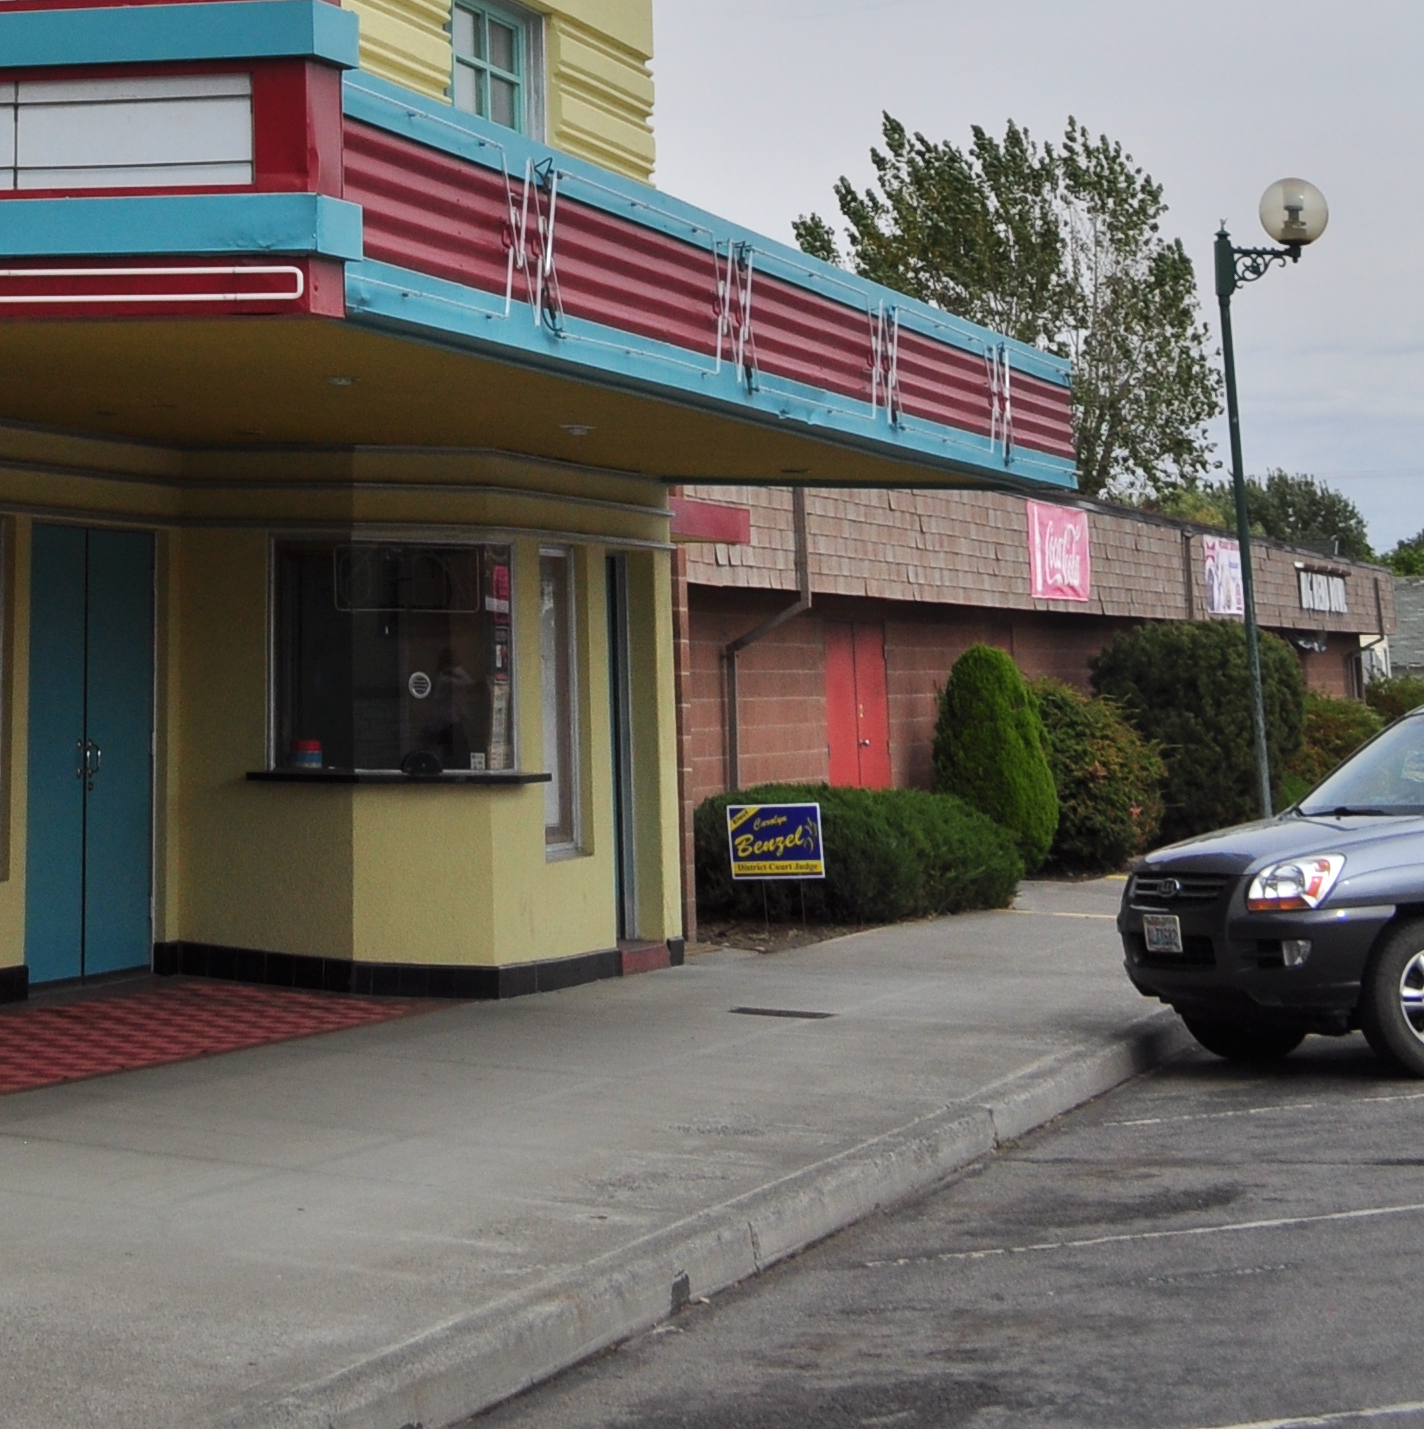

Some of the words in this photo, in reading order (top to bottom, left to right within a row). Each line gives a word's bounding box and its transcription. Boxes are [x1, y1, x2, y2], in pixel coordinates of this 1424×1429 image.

[734, 825, 804, 857] Benzel
[737, 862, 767, 871] District
[769, 862, 793, 871] Court
[794, 861, 818, 872] Judge
